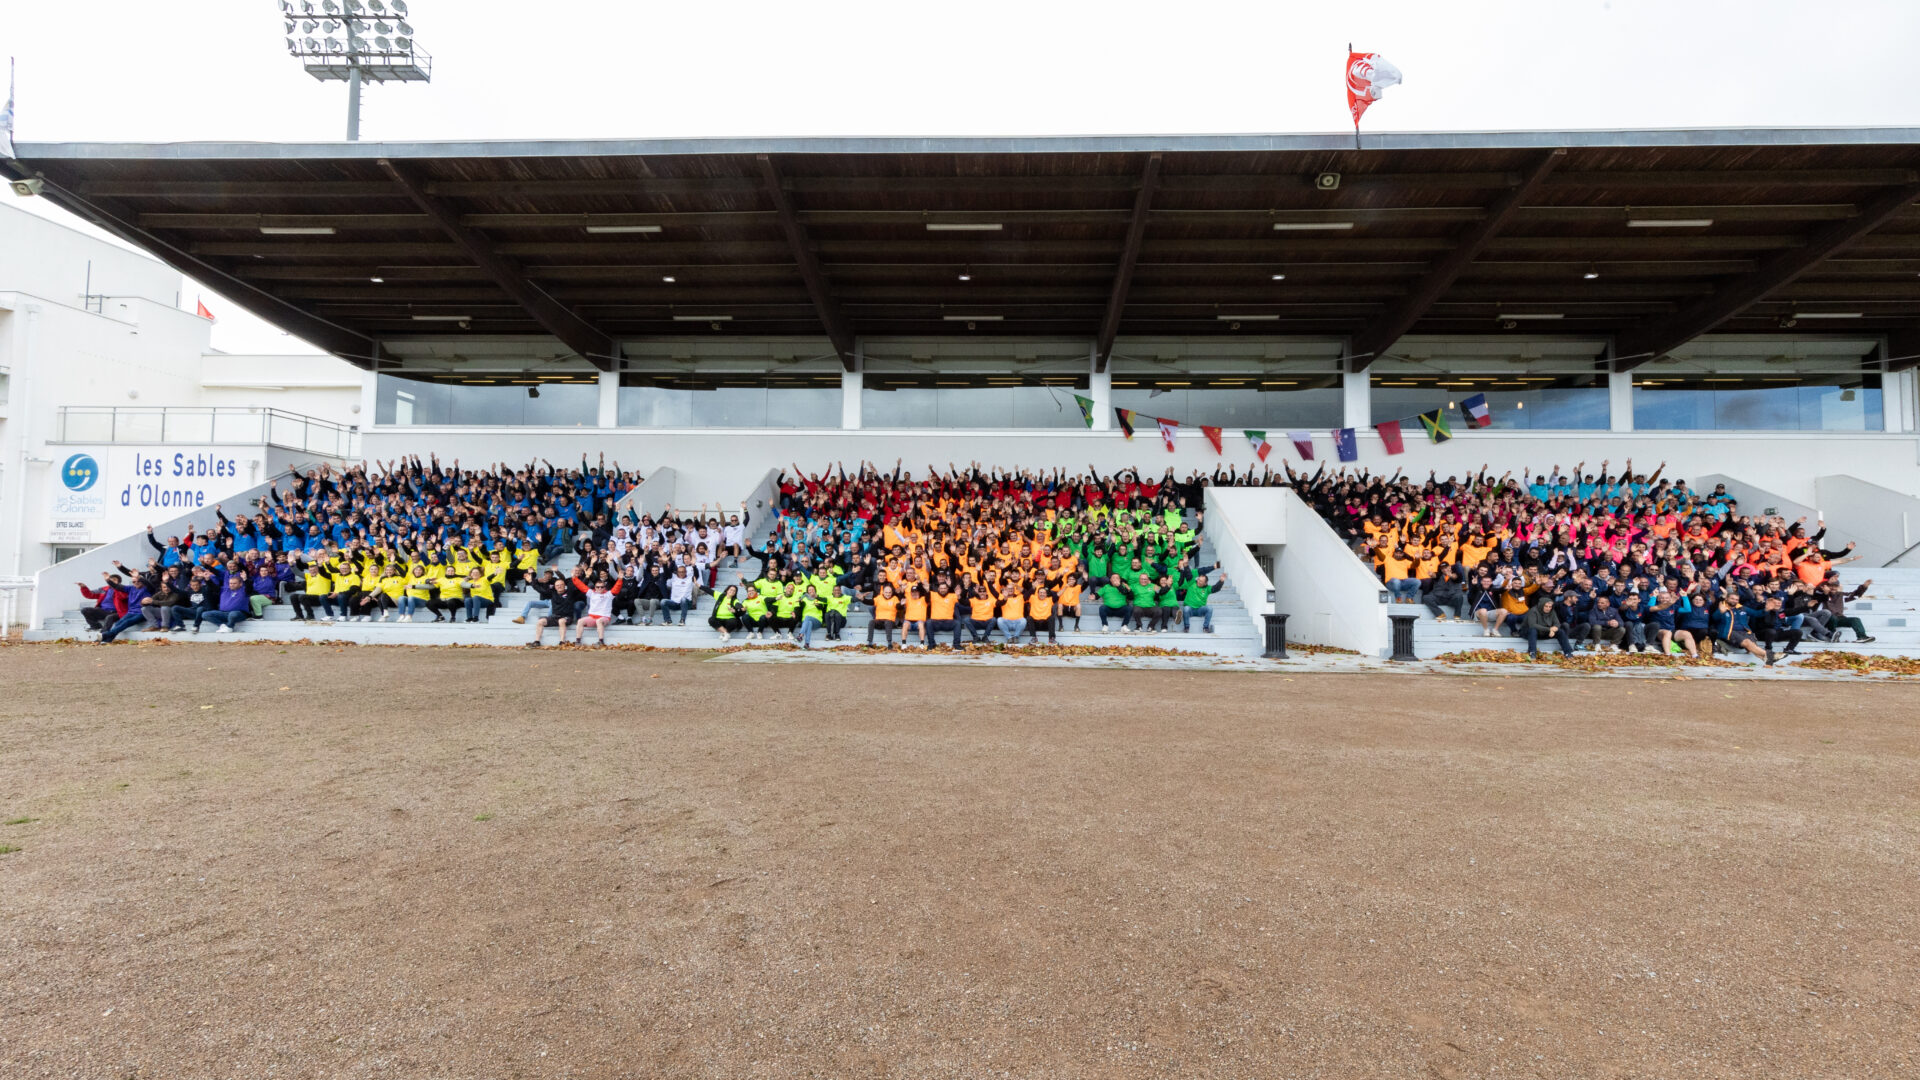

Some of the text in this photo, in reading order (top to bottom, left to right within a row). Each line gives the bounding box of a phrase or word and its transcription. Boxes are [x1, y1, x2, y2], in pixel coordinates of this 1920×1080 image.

[136, 452, 236, 477] les Sables
[69, 494, 103, 504] Sables
